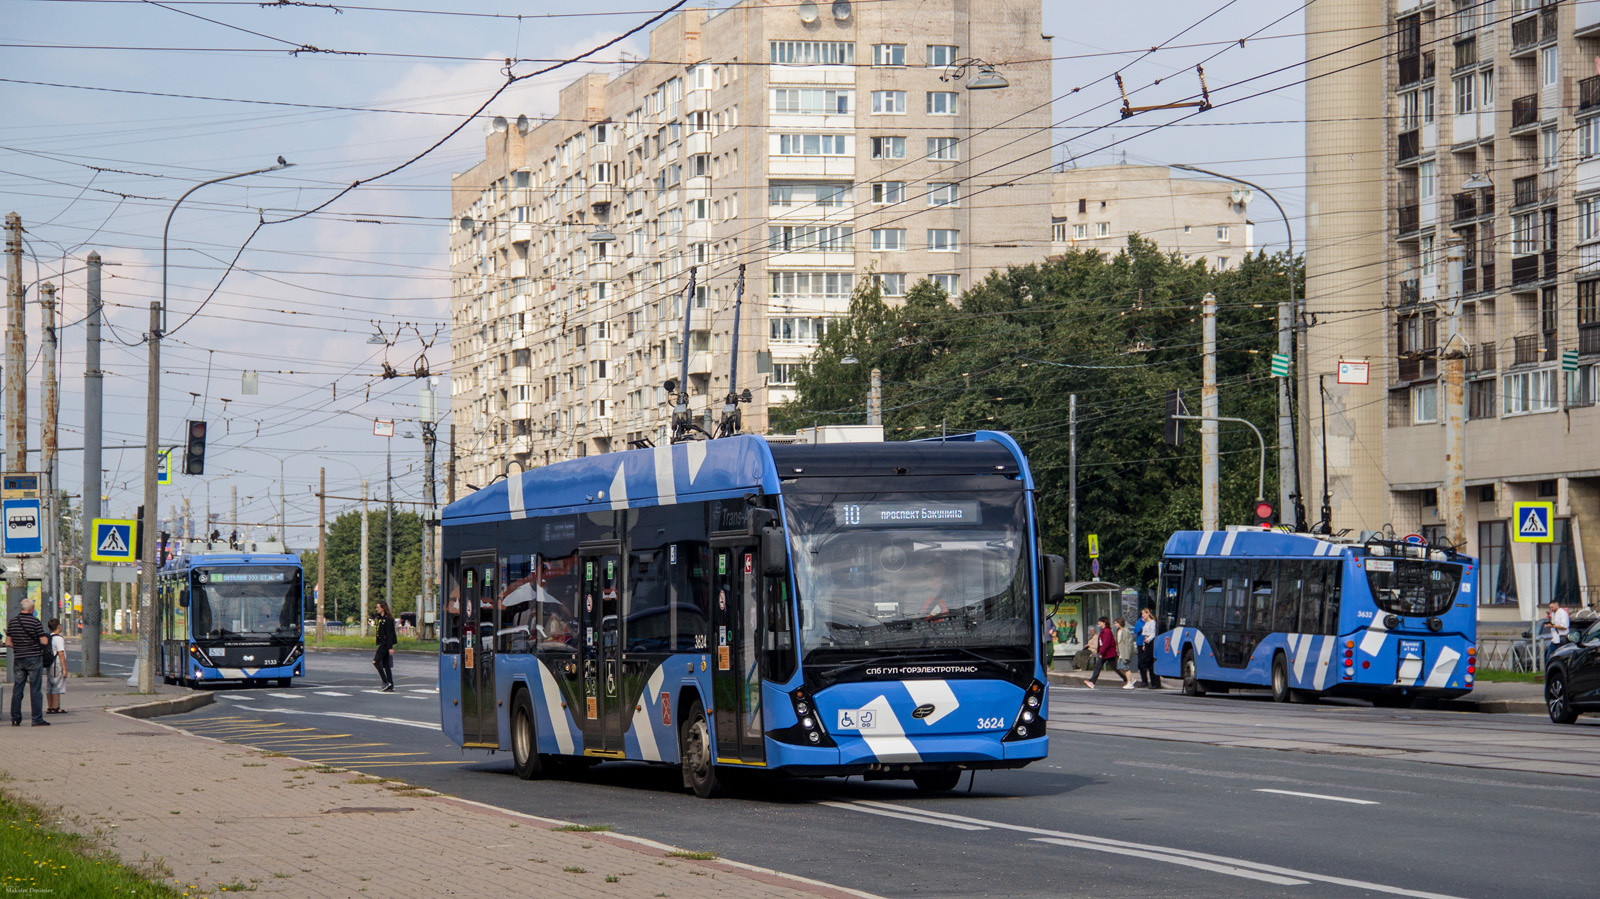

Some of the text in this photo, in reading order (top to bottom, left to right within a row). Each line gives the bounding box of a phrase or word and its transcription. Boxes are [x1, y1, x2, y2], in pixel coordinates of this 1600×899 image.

[843, 505, 963, 525] 10 проспект Бакунина
[1432, 570, 1441, 581] 10
[1357, 611, 1373, 619] 3632
[695, 634, 707, 649] 3624
[977, 717, 1005, 729] 3624
